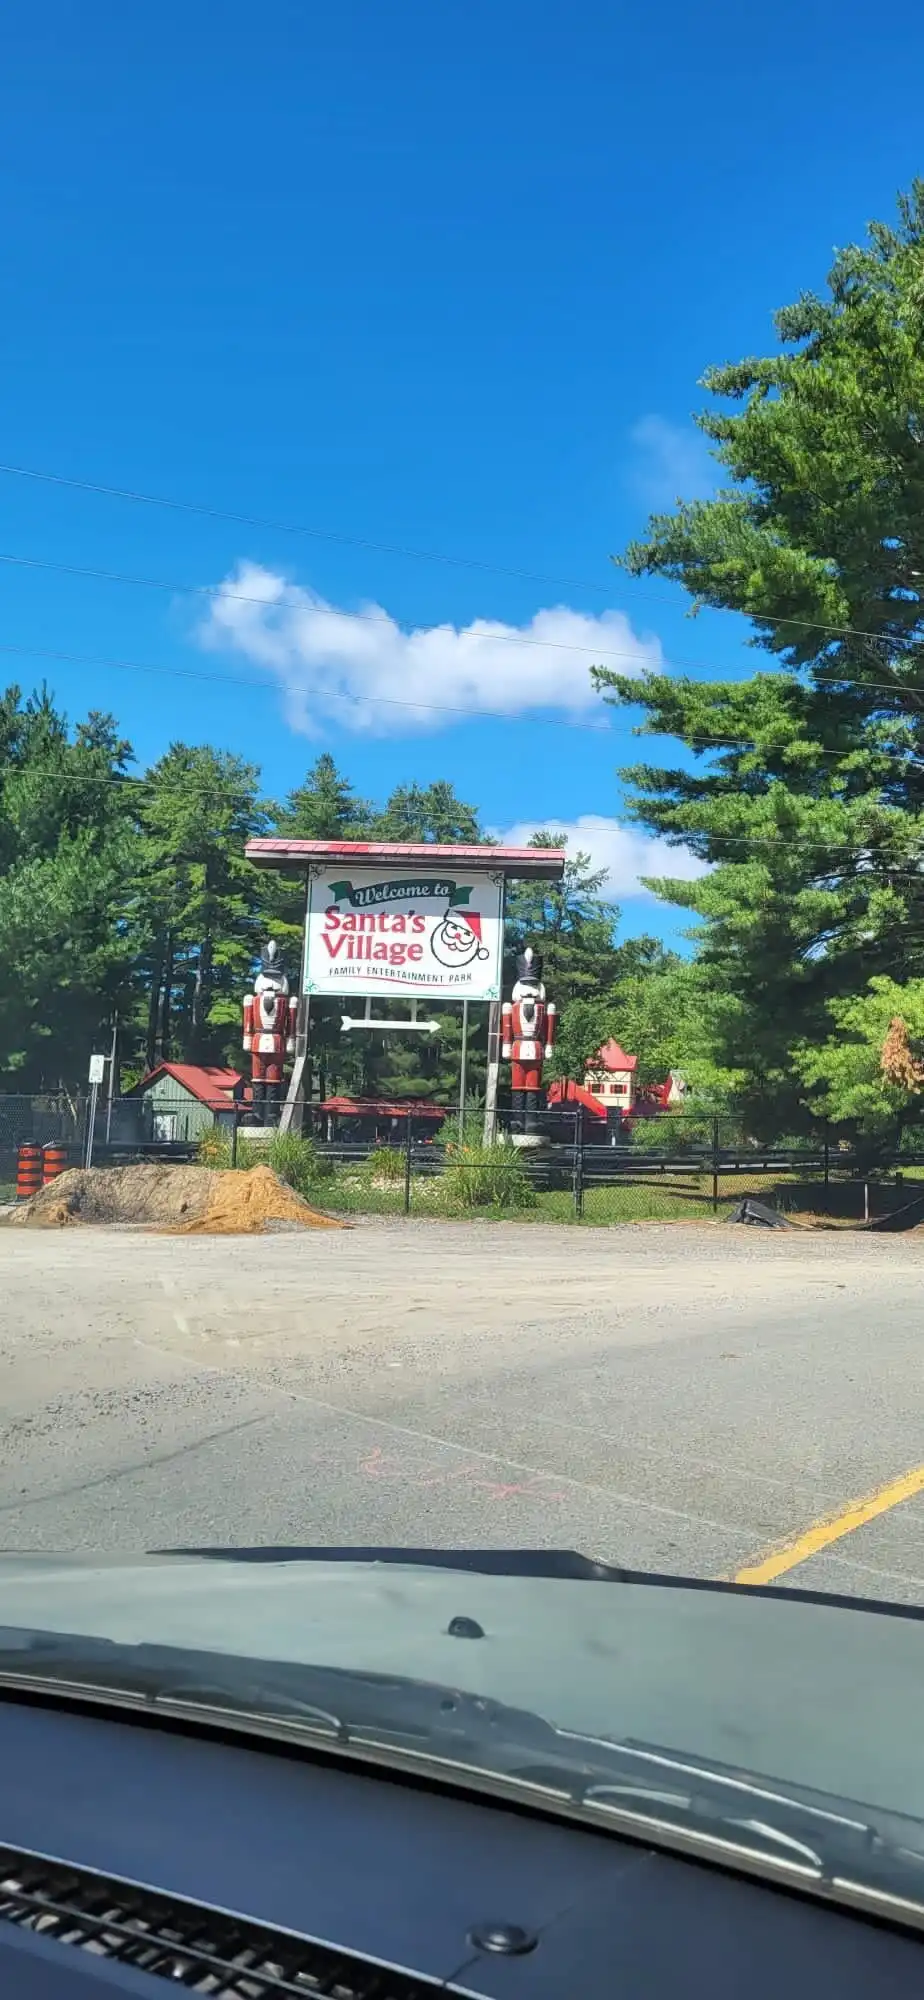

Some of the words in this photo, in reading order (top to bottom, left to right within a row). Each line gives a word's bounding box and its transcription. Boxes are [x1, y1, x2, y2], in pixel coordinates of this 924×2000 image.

[355, 884, 430, 906] Welcome
[434, 883, 450, 896] to
[324, 905, 426, 934] Santa's
[320, 933, 424, 965] Village
[329, 966, 362, 976] FAMILY
[367, 966, 444, 983] ENTERTAINMENT
[449, 972, 473, 982] PARK
